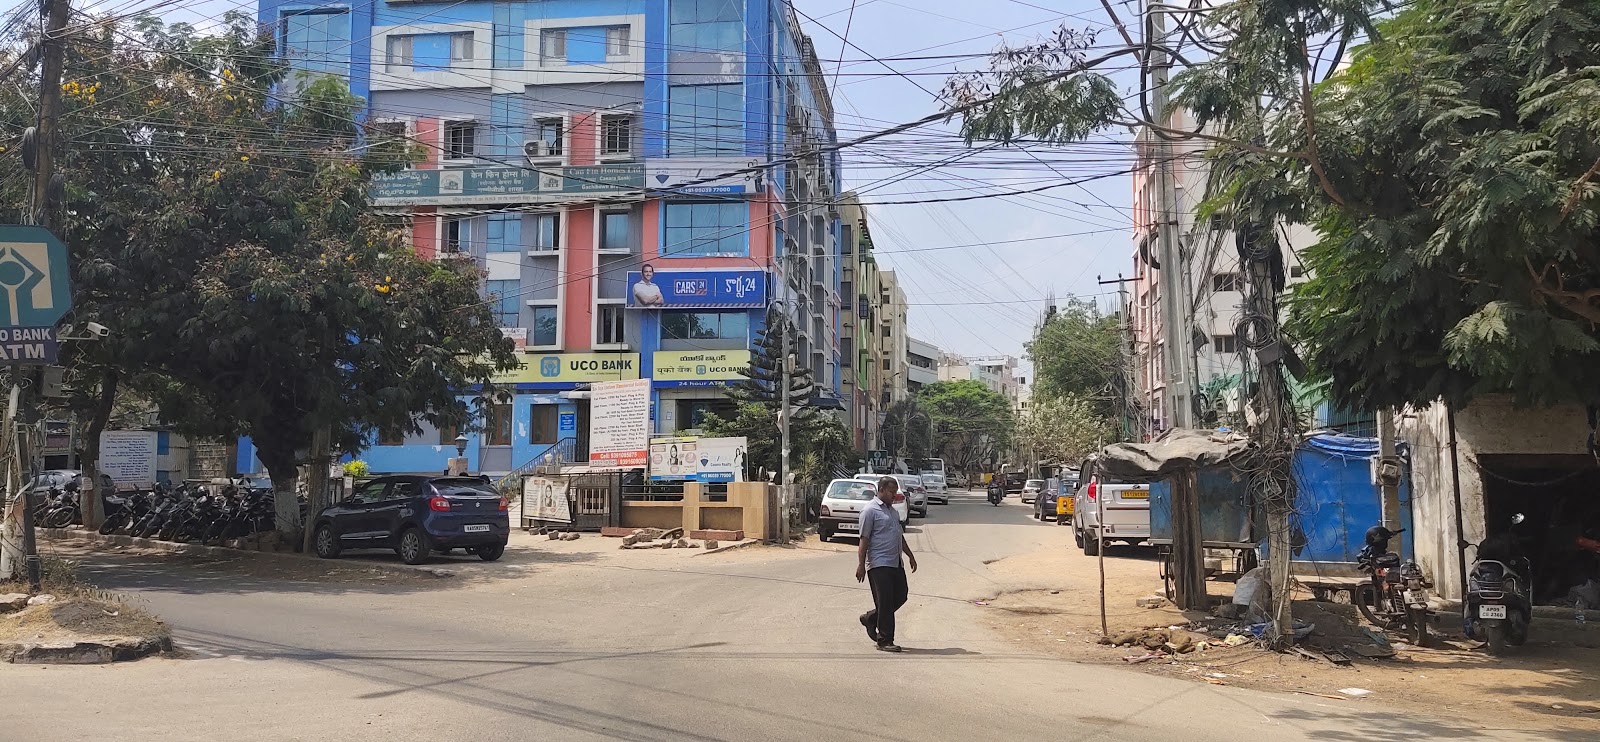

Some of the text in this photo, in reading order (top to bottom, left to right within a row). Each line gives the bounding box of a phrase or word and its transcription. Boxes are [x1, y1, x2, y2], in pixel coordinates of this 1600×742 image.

[676, 282, 696, 294] CARS
[13, 328, 51, 341] BANK
[570, 360, 632, 370] UCO BANK
[869, 458, 887, 466] ATM
